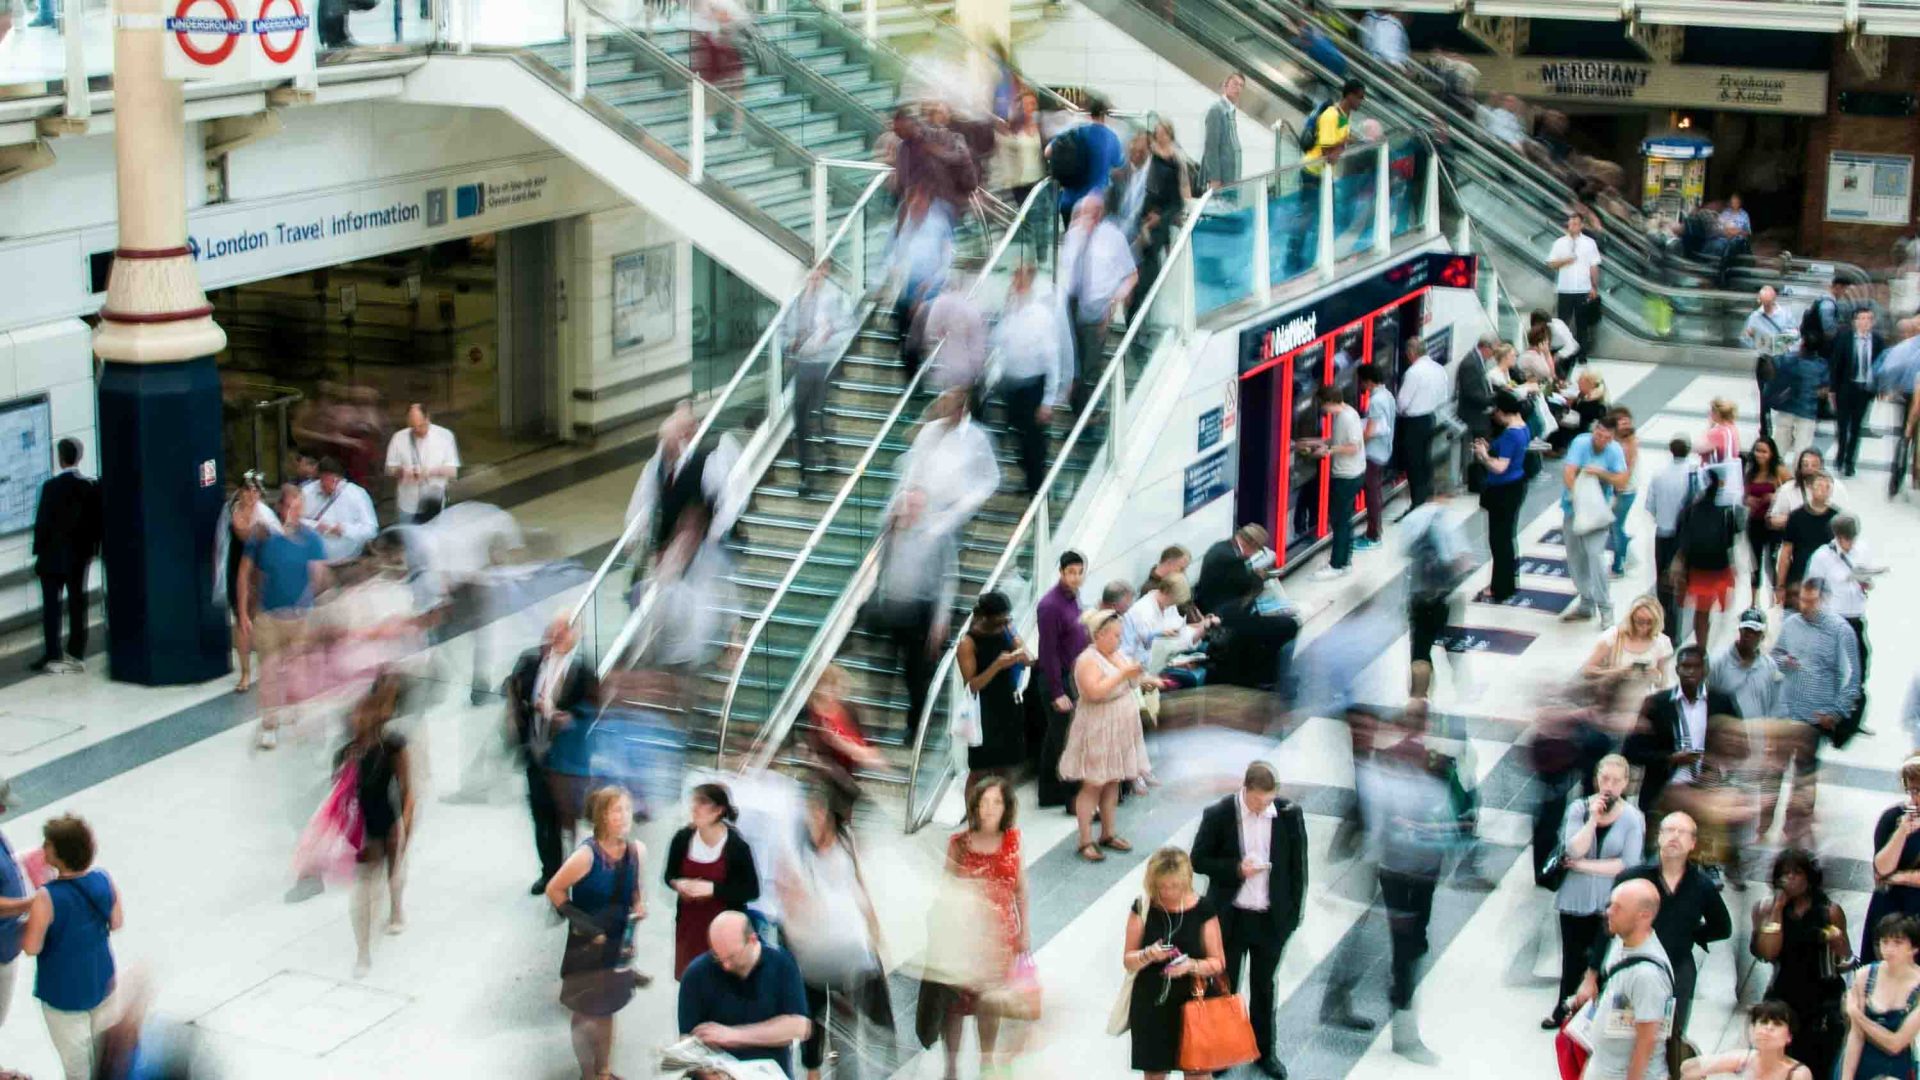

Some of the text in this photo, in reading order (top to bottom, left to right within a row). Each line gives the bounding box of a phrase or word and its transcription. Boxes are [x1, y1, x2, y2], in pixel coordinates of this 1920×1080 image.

[171, 18, 243, 31] UNDERGROUND
[255, 17, 308, 30] UNDERGROUND
[1541, 61, 1651, 86] MERCHANT
[206, 229, 269, 260] London
[276, 217, 325, 244] Travel
[332, 201, 420, 236] Information
[1275, 311, 1317, 357] NatWest
